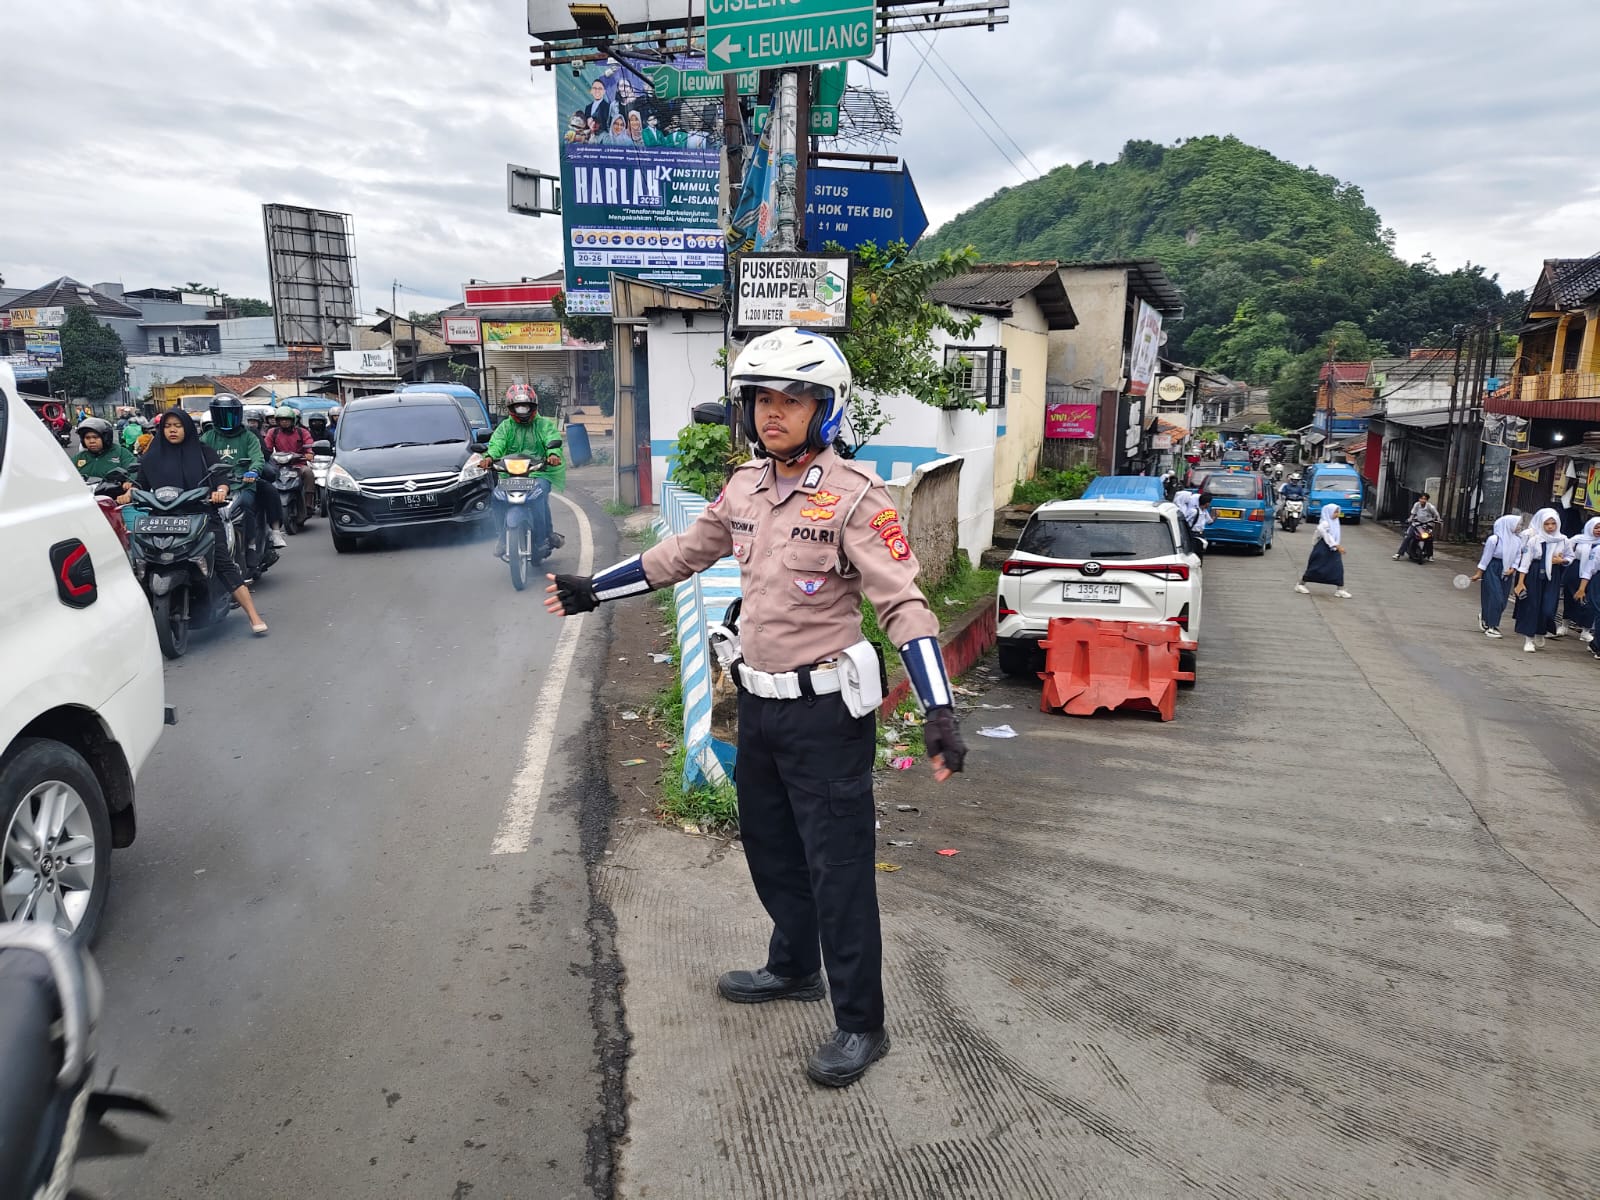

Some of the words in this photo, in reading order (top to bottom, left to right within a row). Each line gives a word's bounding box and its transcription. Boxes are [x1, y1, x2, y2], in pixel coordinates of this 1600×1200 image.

[748, 22, 868, 58] LEUWILIANG
[682, 70, 757, 93] leuwilng
[673, 168, 720, 179] INSTITUT
[574, 166, 660, 205] HARLAH
[671, 181, 711, 193] UMMUL
[814, 185, 849, 198] SITUS
[817, 203, 842, 216] HOK
[847, 205, 870, 217] TEK
[872, 206, 893, 219] BIO
[835, 222, 849, 232] KM
[578, 254, 602, 262] 20-26
[742, 261, 817, 279] PUSKESMAS
[740, 282, 808, 299] CIAMPEA
[745, 310, 760, 321] 1.200
[762, 309, 784, 321] METER
[791, 527, 835, 543] POLRI
[1065, 584, 1071, 593] F
[1077, 584, 1099, 594] 1354
[1103, 585, 1118, 595] FAY
